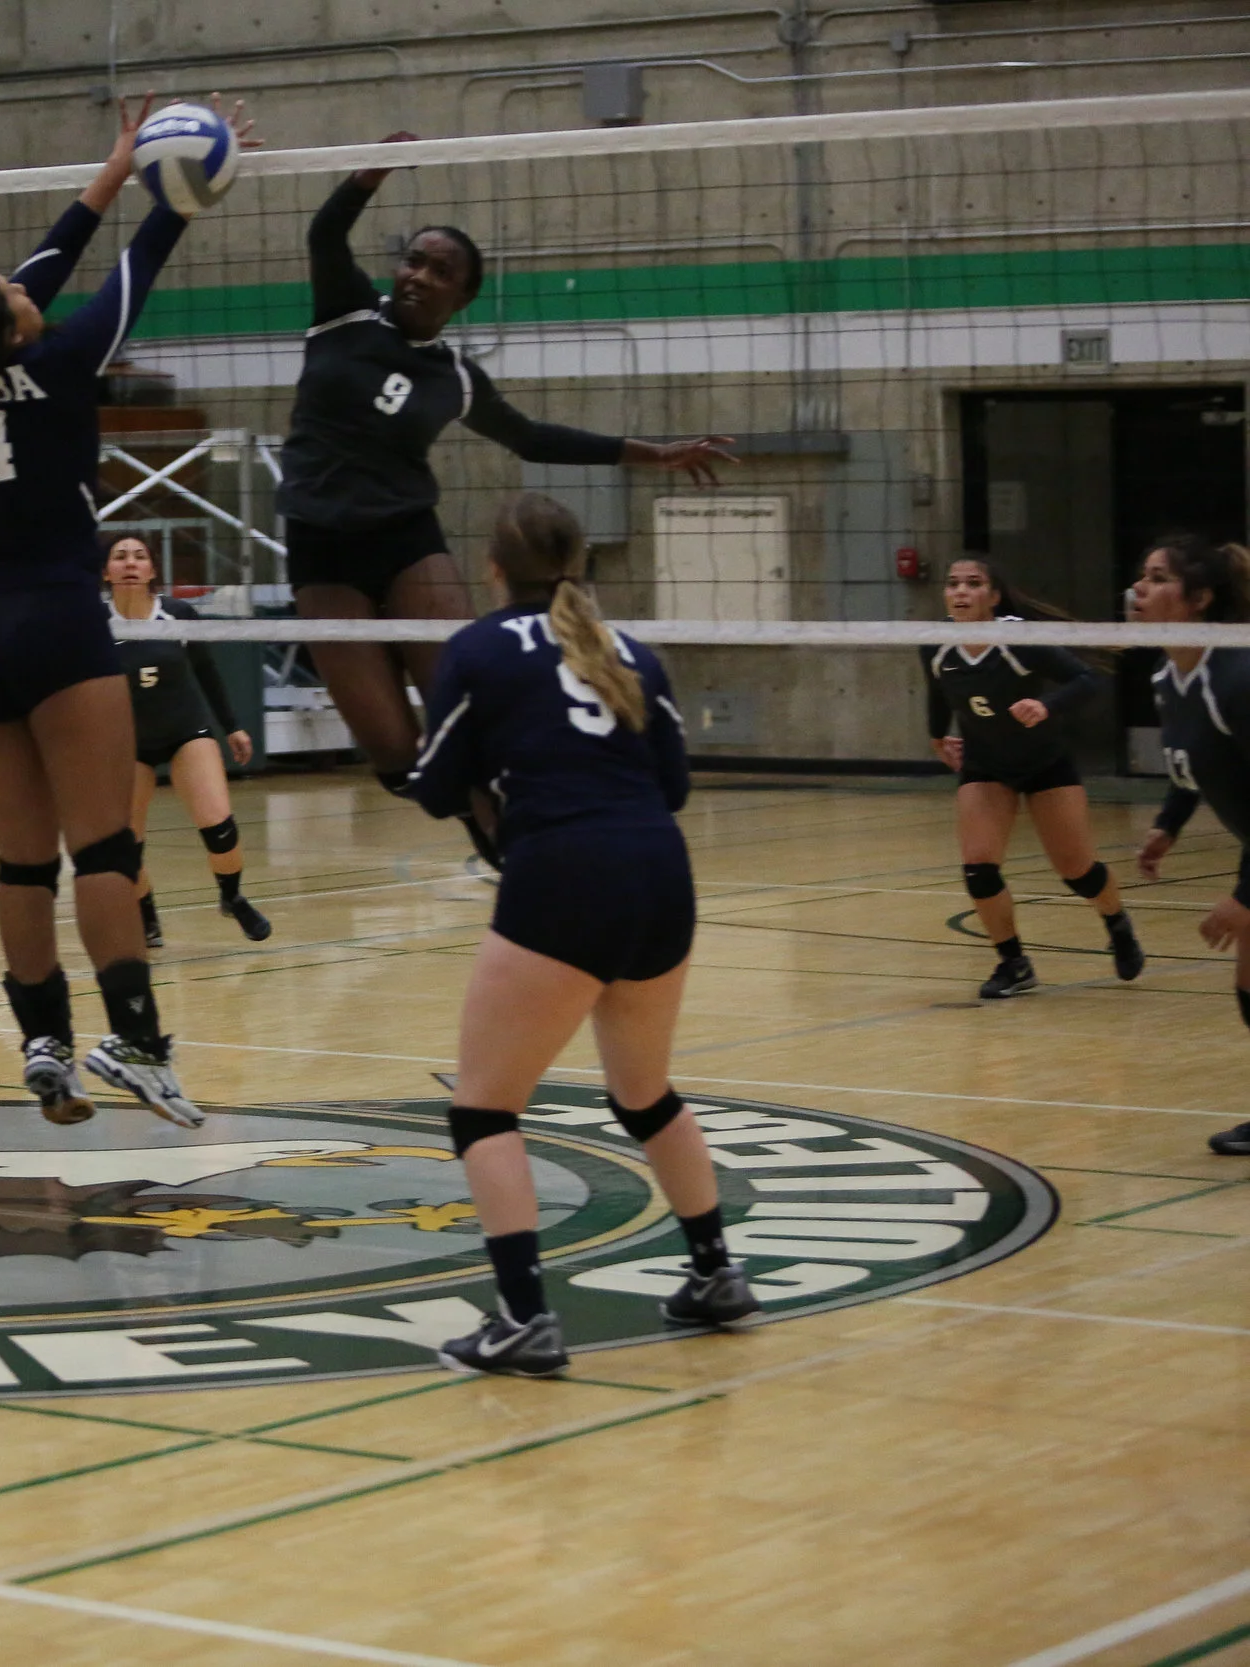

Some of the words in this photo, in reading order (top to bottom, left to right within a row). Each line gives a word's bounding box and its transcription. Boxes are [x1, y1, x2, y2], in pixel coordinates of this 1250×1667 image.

[1068, 337, 1104, 361] EXIT
[373, 372, 413, 416] 9
[139, 666, 159, 688] 5
[969, 695, 995, 717] 6
[517, 1096, 990, 1302] COLLEGE
